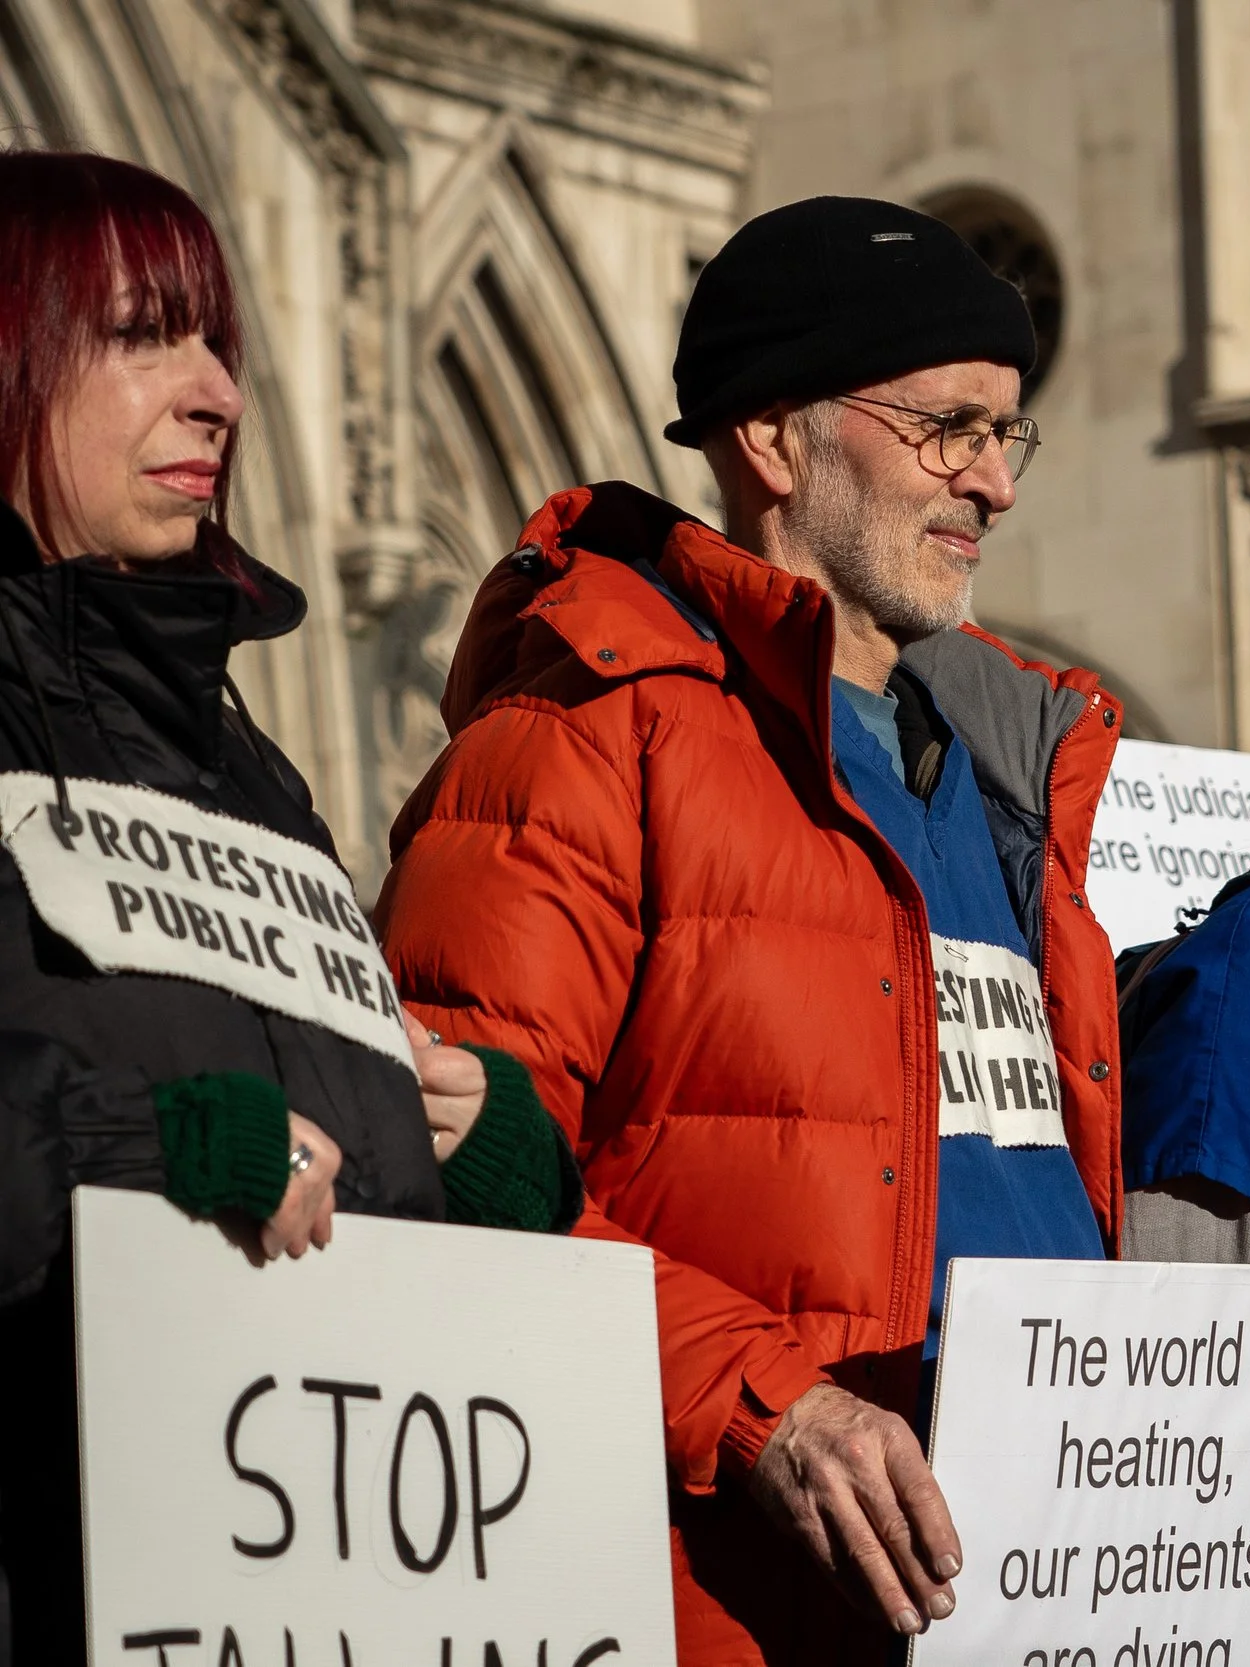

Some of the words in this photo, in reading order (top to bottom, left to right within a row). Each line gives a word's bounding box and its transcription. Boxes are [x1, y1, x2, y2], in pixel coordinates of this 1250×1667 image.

[46, 803, 369, 945] PROTESTING
[1090, 838, 1141, 872] are
[106, 880, 298, 980] PUBLIC
[1021, 1318, 1108, 1387] The
[1125, 1321, 1244, 1387] world
[223, 1373, 532, 1580] STOP
[1056, 1420, 1233, 1504] heating,
[1000, 1543, 1081, 1601] our
